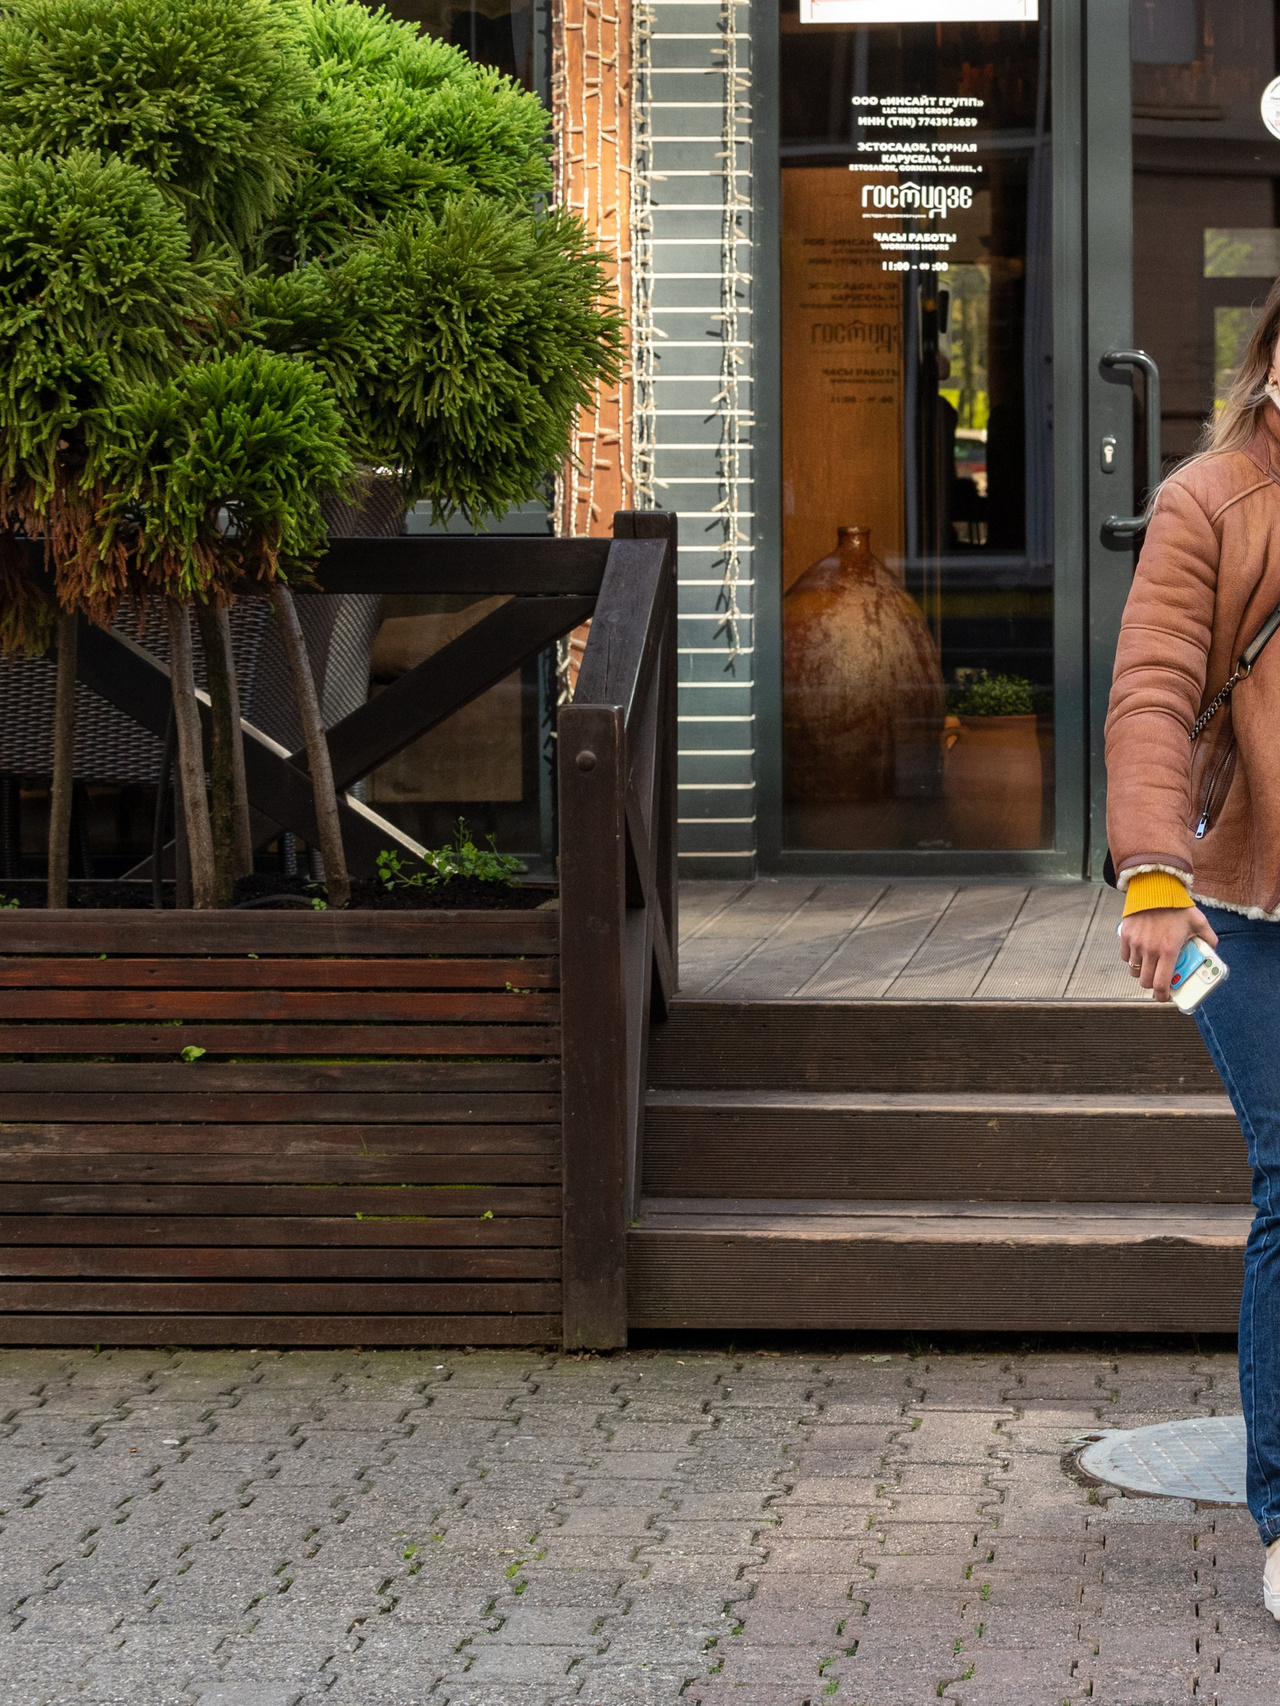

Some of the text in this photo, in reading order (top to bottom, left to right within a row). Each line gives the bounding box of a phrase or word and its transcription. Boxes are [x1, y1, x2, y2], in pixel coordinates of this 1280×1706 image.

[852, 95, 984, 108] ООО «ИНСАЙТ ГРУПП»
[858, 117, 978, 129] ИНН (TIN) 7743912659
[857, 142, 978, 153] ЭСТОСАДОК, ГОРНАЯ
[881, 154, 950, 165] КАРУСЕЛЬ, 4
[849, 164, 898, 172] ESTOSADOK,
[899, 164, 938, 172] GORNAYA
[938, 165, 977, 173] KARUSEL,
[873, 232, 957, 242] ЧАСЫ РАБОТЫ
[882, 261, 910, 271] 11:00
